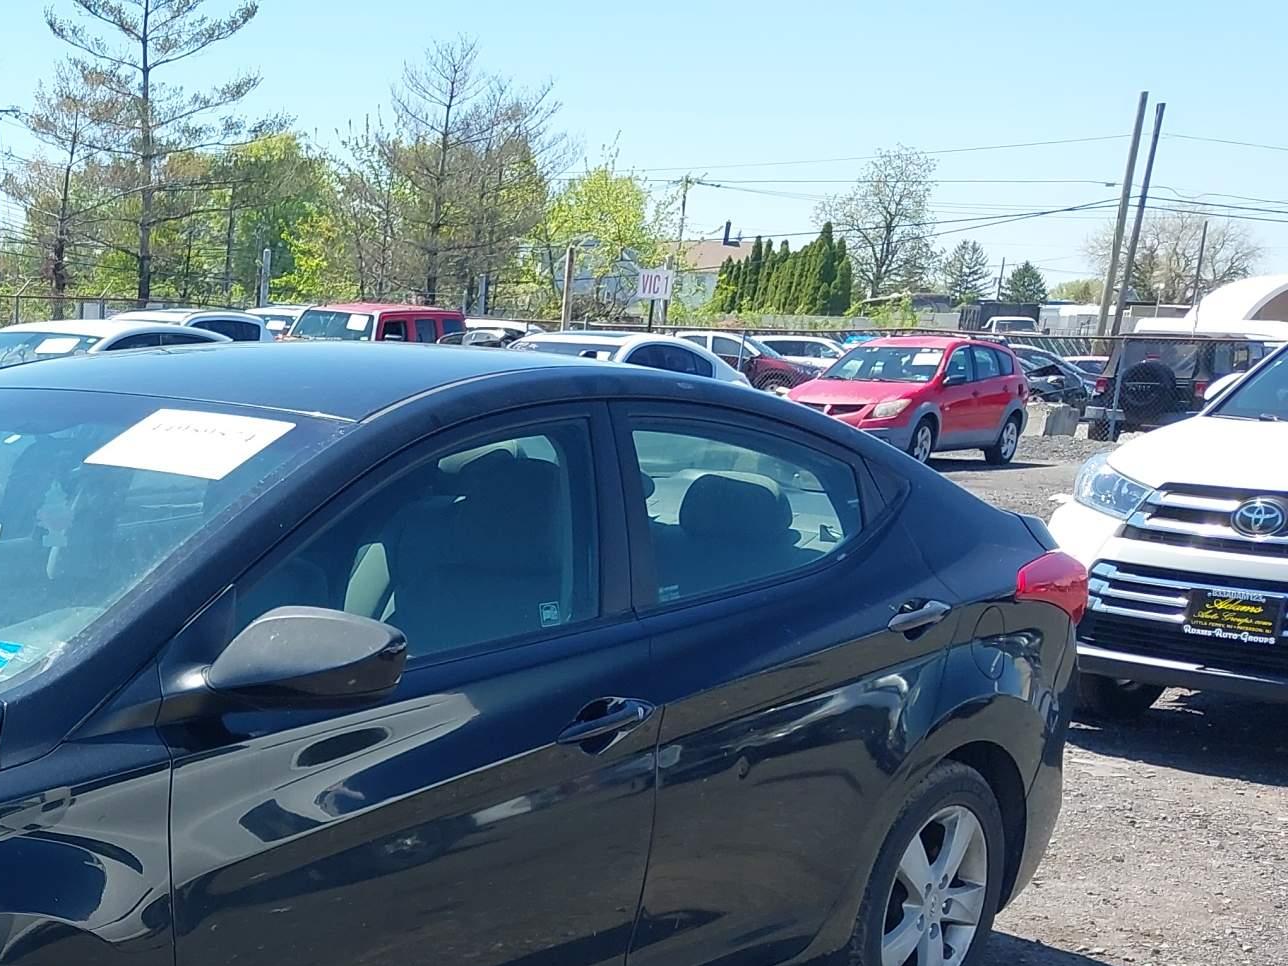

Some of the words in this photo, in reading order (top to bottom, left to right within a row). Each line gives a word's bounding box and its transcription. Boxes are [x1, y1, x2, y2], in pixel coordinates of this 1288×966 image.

[642, 274, 661, 294] VIC
[664, 275, 669, 295] 1
[1205, 598, 1264, 613] Adams
